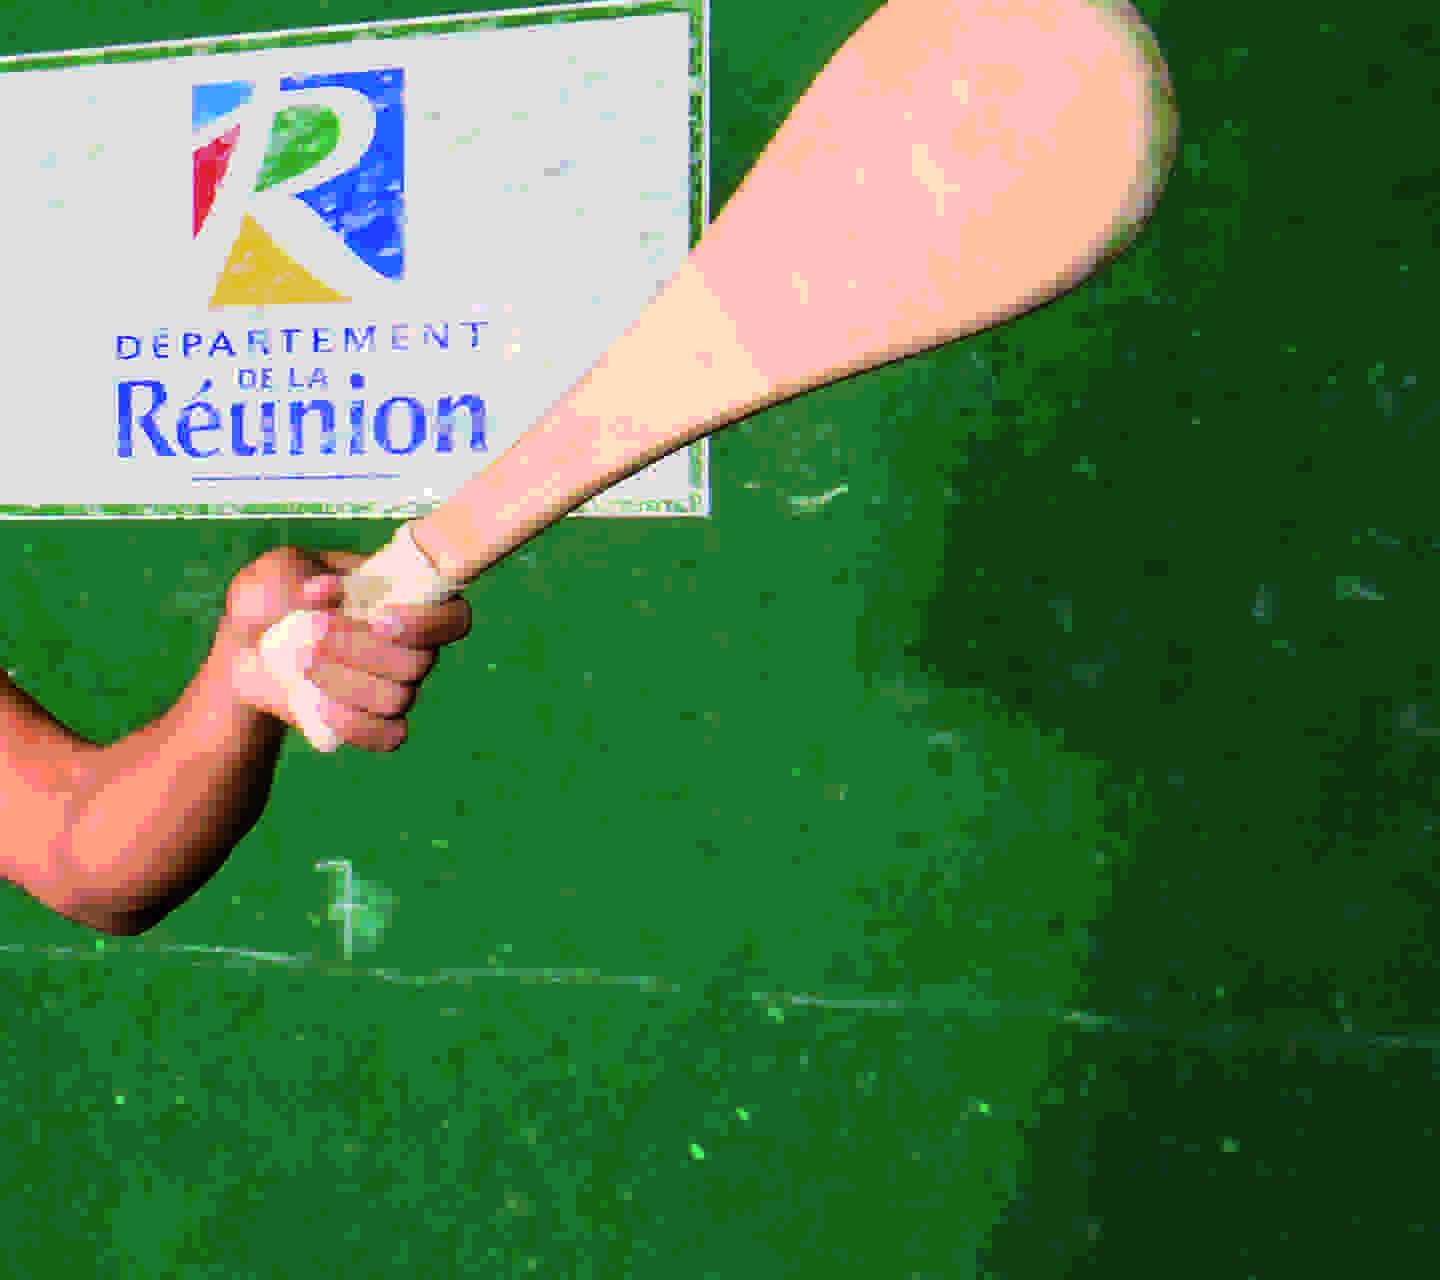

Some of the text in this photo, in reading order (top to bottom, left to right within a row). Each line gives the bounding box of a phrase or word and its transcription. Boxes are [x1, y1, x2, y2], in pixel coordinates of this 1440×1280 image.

[235, 368, 329, 392] DE LA
[114, 370, 489, 458] Réunion
